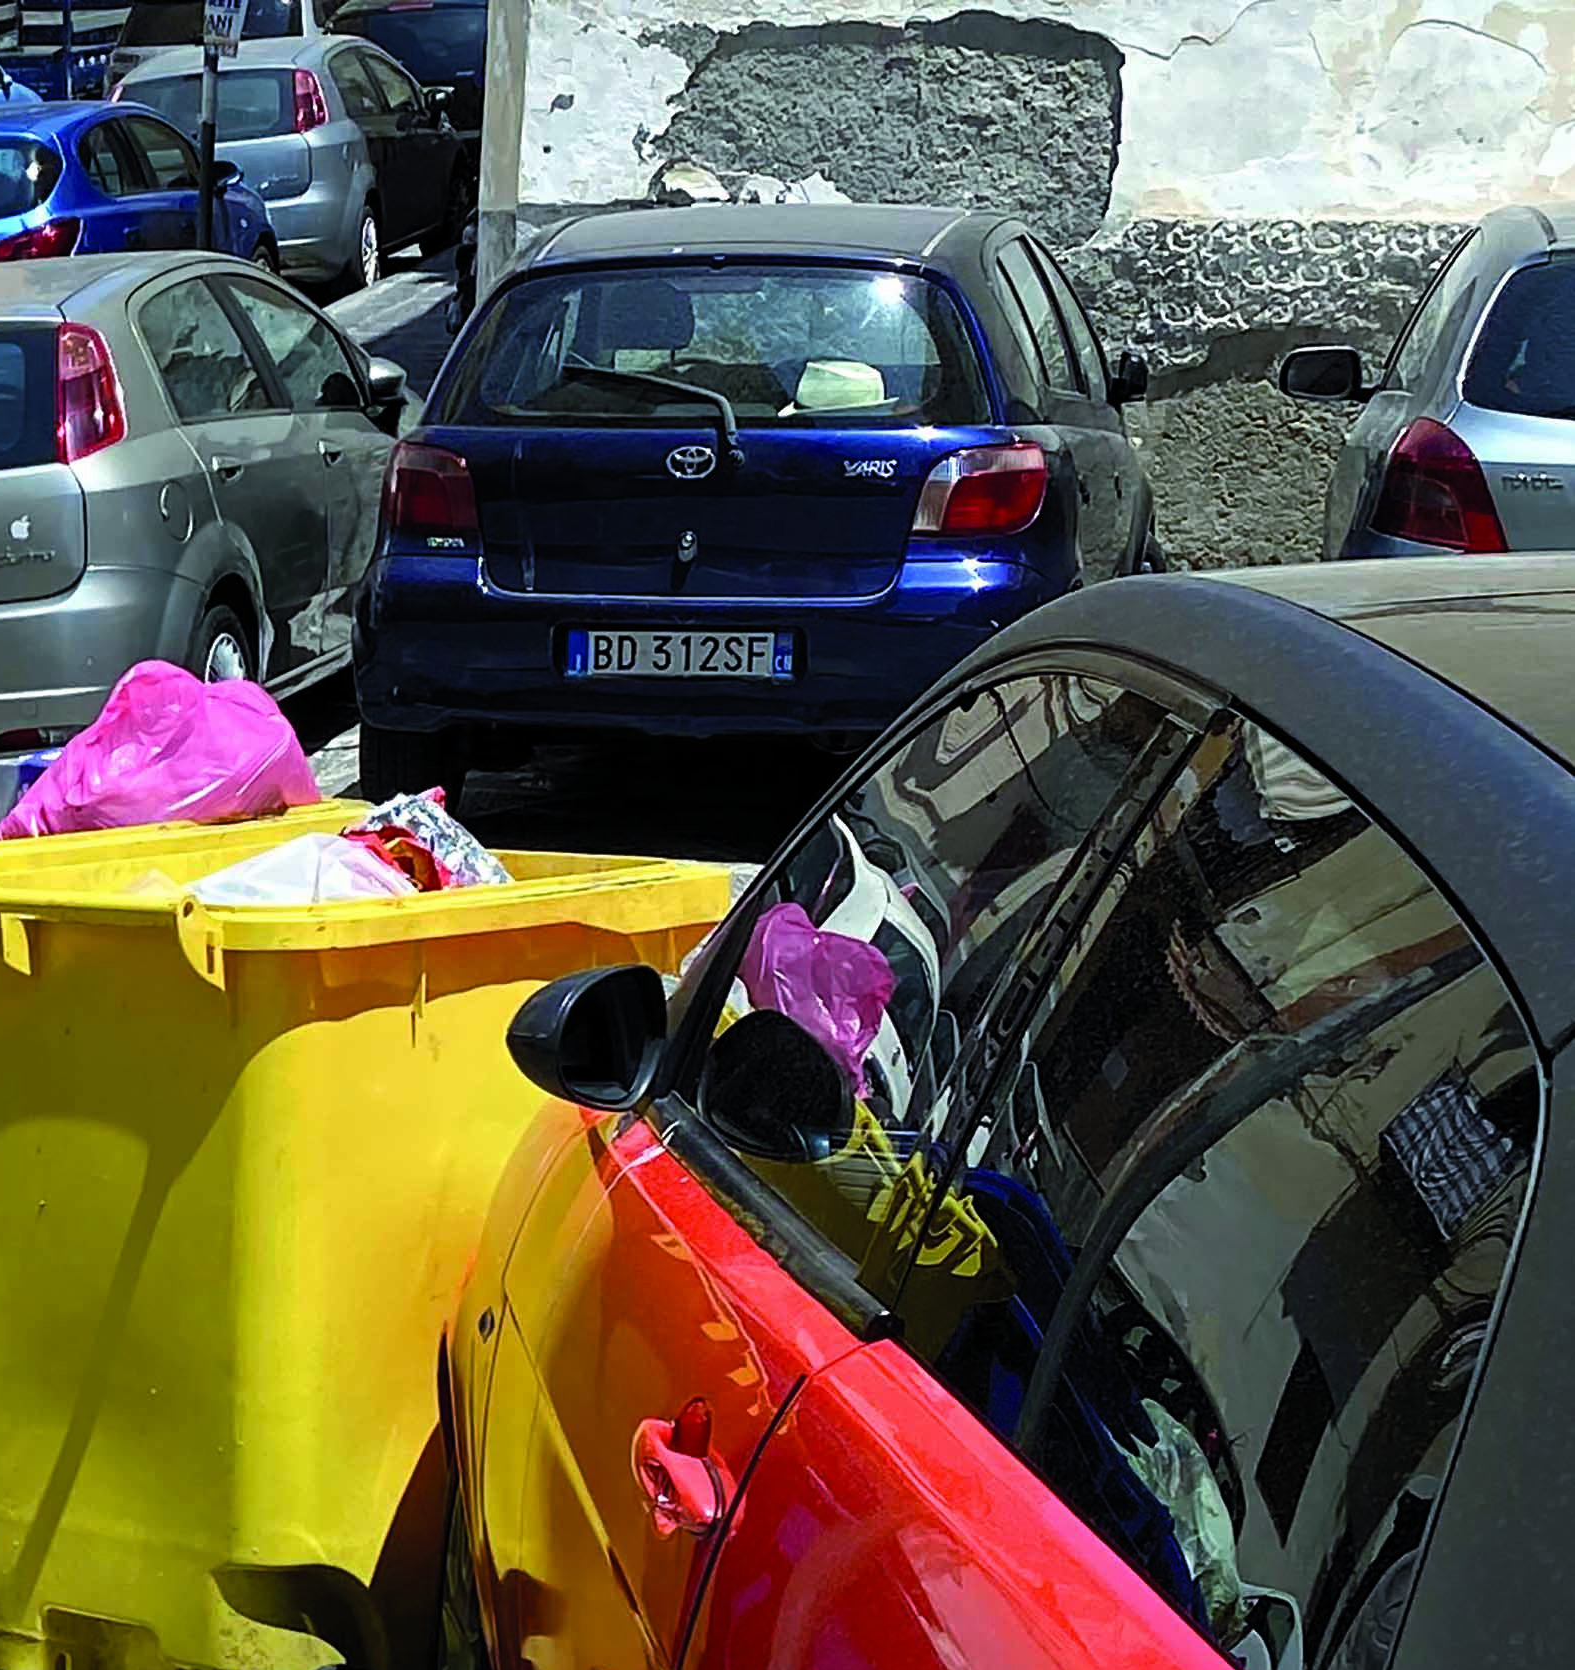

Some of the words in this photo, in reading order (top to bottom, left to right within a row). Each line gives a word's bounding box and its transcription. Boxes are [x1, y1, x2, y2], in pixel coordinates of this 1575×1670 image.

[843, 459, 898, 478] YARIS
[593, 634, 638, 671] BD
[652, 634, 769, 673] 312SF
